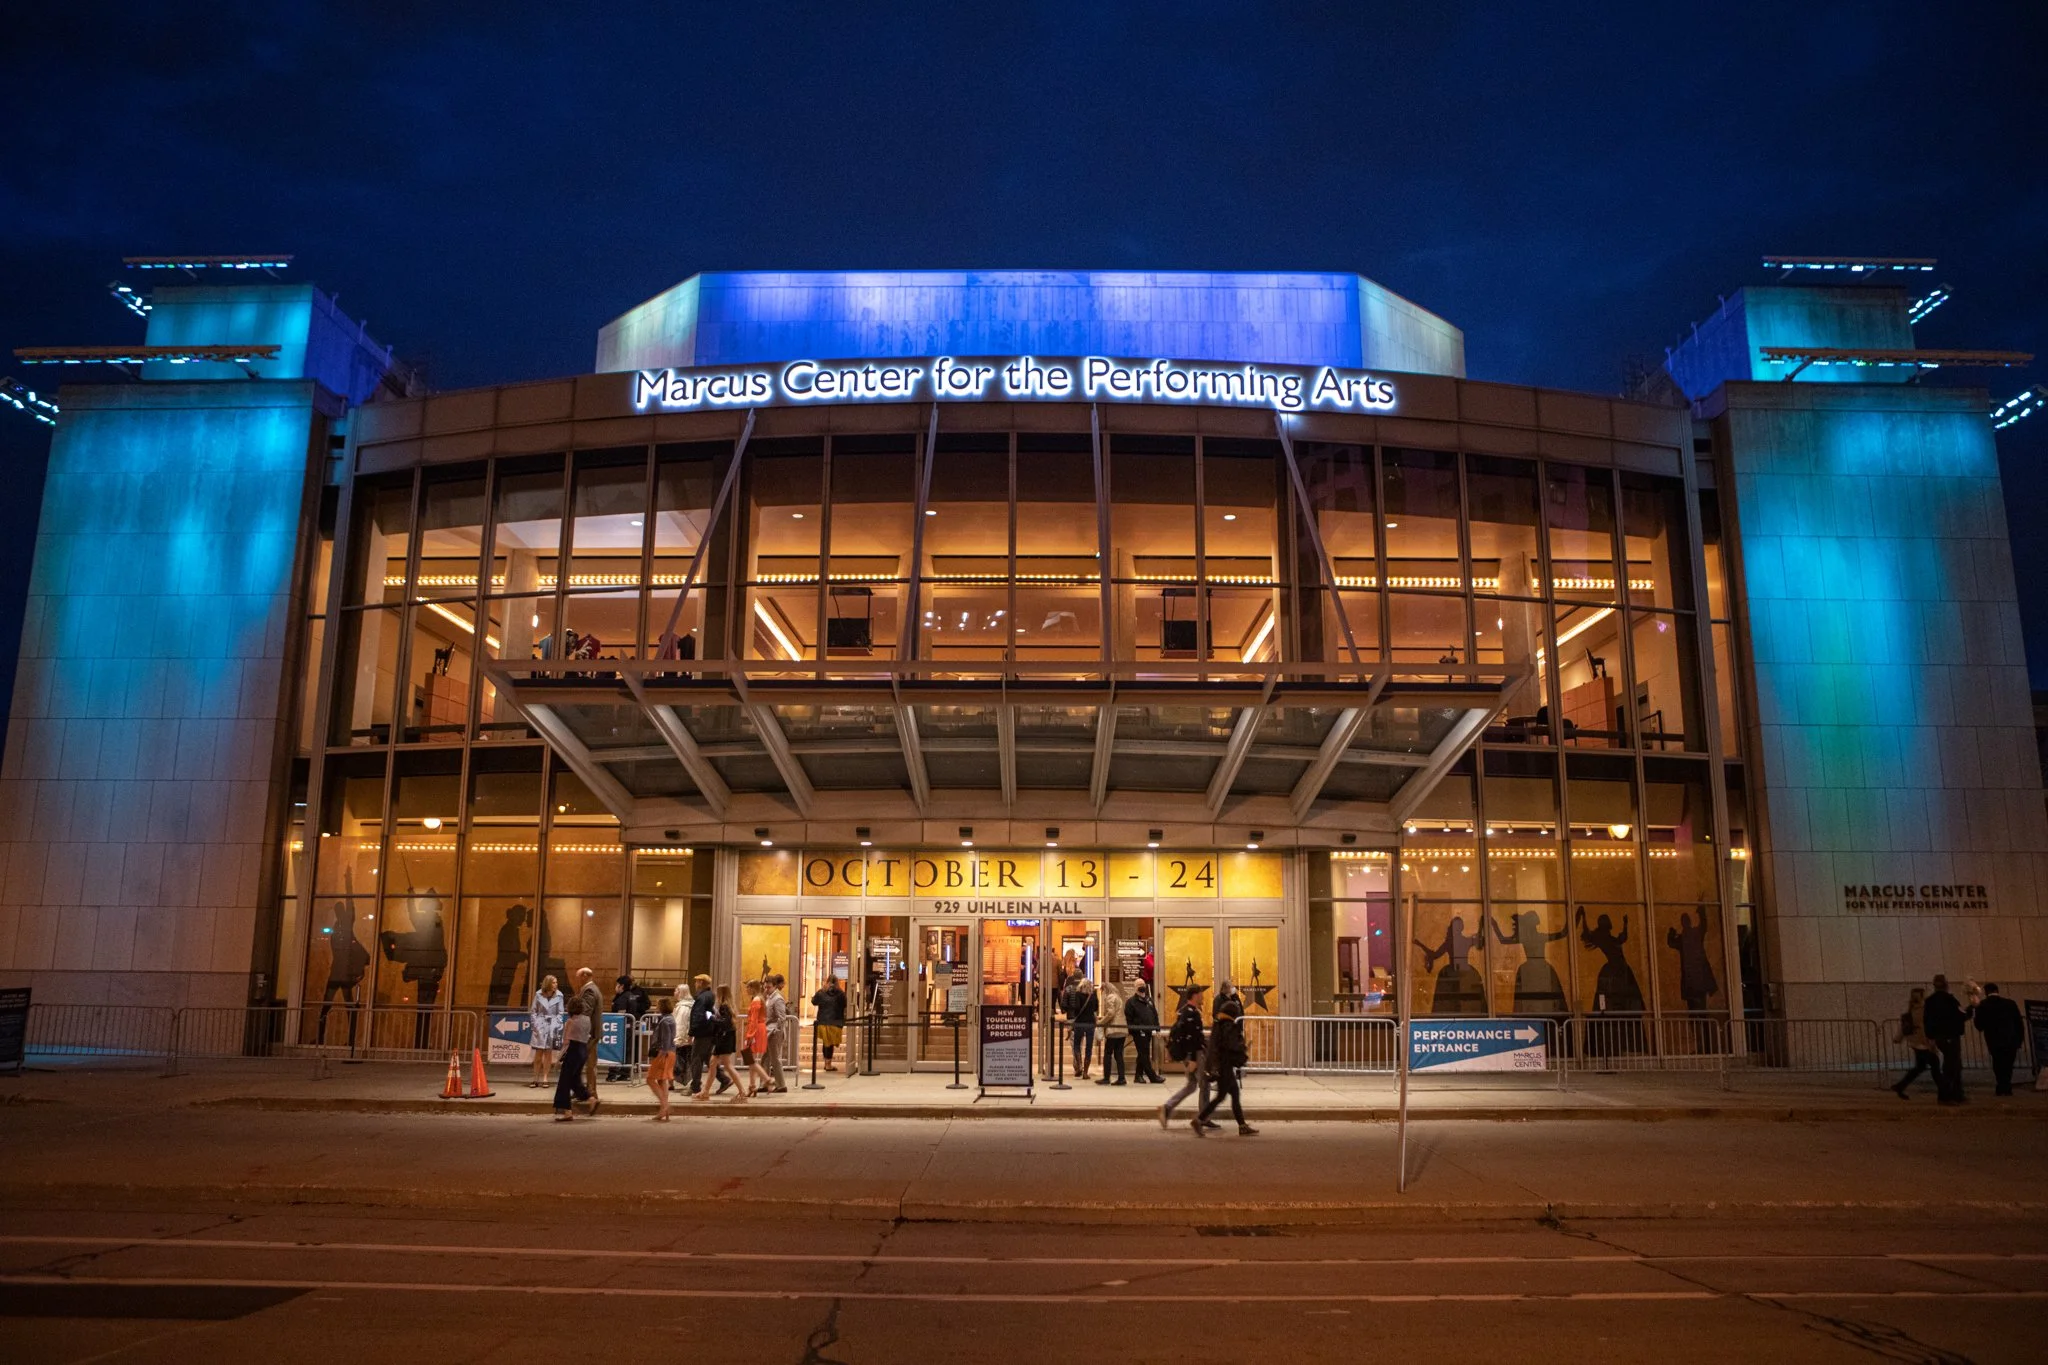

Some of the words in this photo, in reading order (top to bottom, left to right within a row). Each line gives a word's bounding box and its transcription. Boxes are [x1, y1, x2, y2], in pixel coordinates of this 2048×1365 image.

[635, 369, 767, 404] Marcus
[783, 360, 921, 395] Center
[934, 357, 991, 390] for
[1005, 356, 1068, 390] the
[1087, 358, 1302, 408] Performing
[1315, 367, 1395, 405] Arts
[805, 858, 1024, 888] OCTOBER
[1056, 859, 1098, 889] 13
[1169, 860, 1215, 889] 24
[1844, 885, 1915, 898] MARCUS
[1919, 885, 1987, 898] CENTER
[934, 901, 960, 914] 929
[967, 901, 1033, 914] UIHLEIN
[1039, 902, 1082, 915] HALL
[1846, 900, 1866, 909] FOR
[1868, 900, 1889, 909] THE
[1892, 900, 1960, 909] PERFORMING
[1963, 900, 1989, 909] ARTS
[1413, 1030, 1511, 1040] PERFORMANCE
[1414, 1043, 1479, 1053] ENTRANCE
